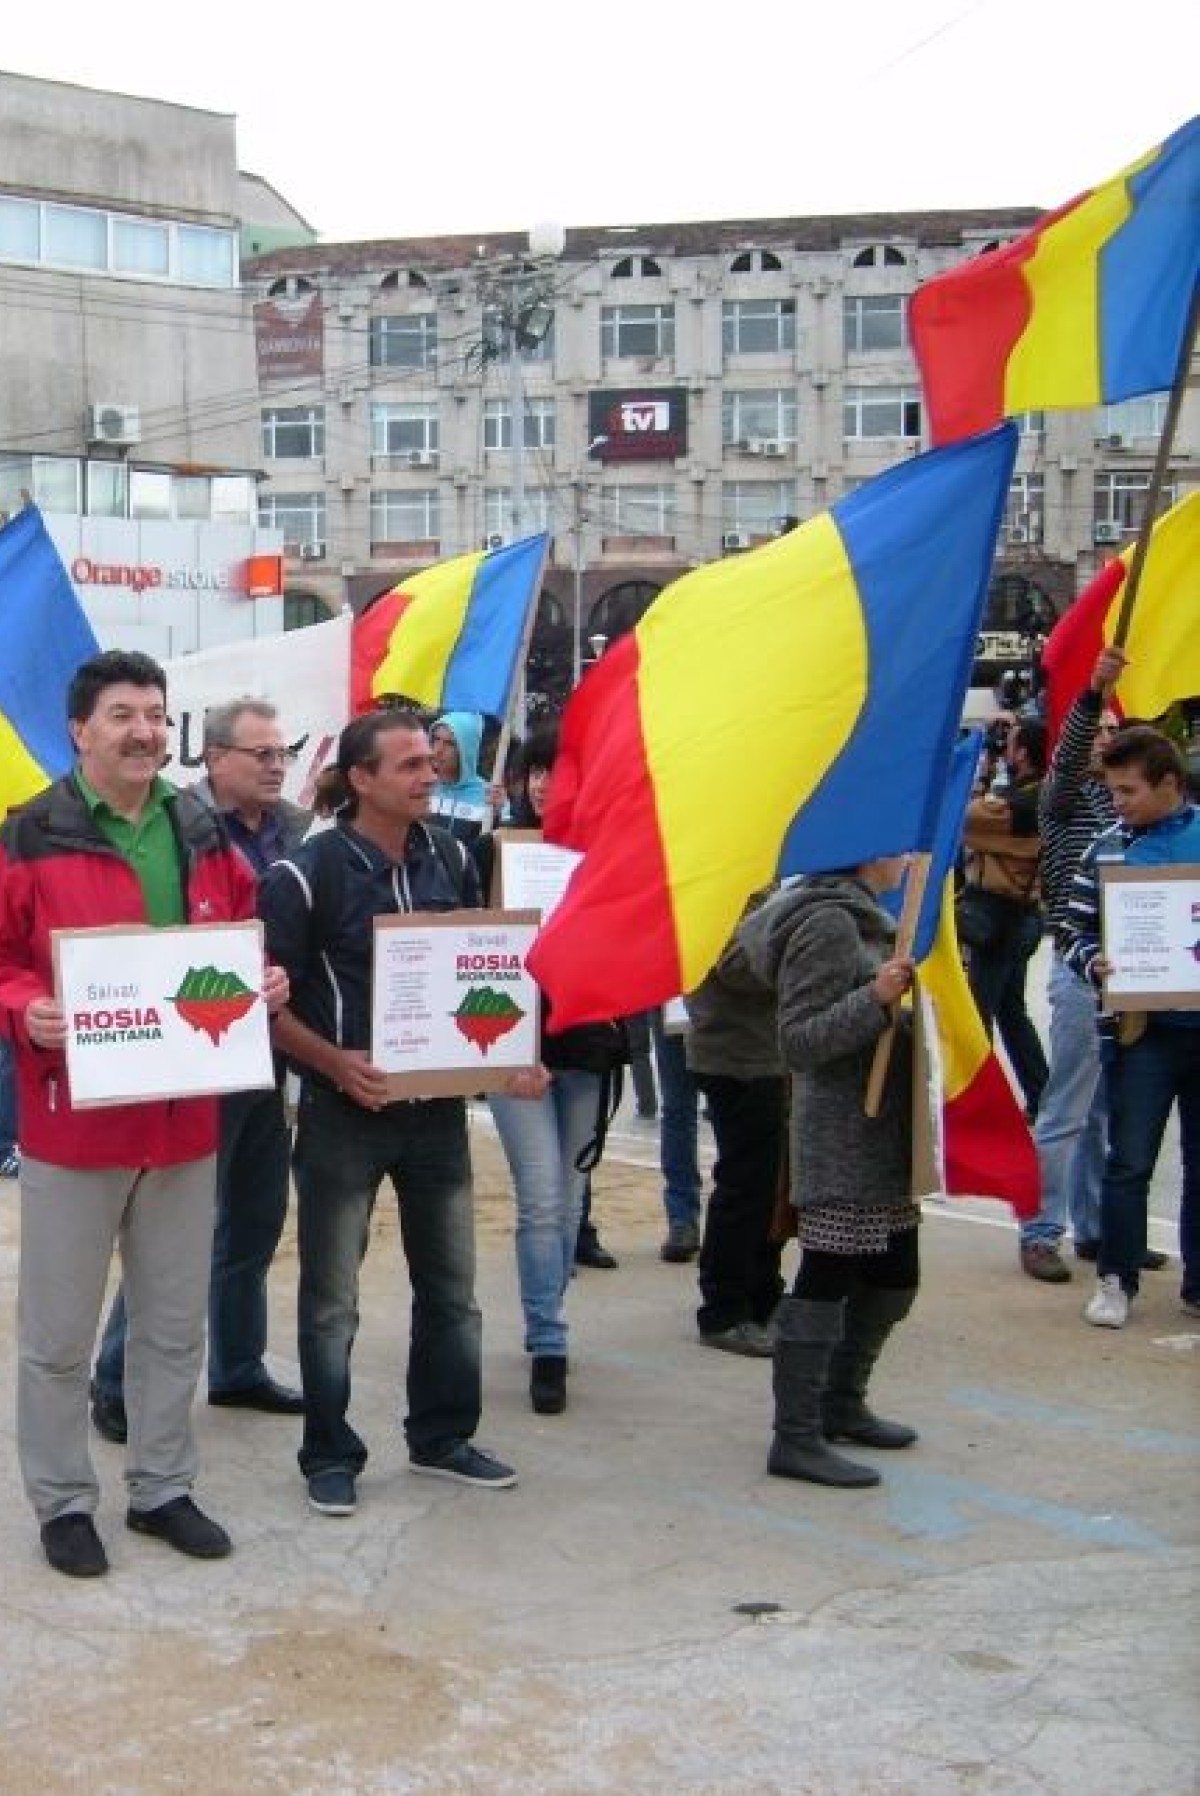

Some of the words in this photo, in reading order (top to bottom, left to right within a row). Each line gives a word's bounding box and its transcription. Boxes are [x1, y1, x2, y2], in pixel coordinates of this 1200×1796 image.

[71, 557, 161, 592] Orange
[456, 954, 522, 970] ROSIA
[456, 971, 522, 981] MONTANA
[73, 1008, 162, 1031] ROSIA
[76, 1028, 163, 1046] MONTANA
